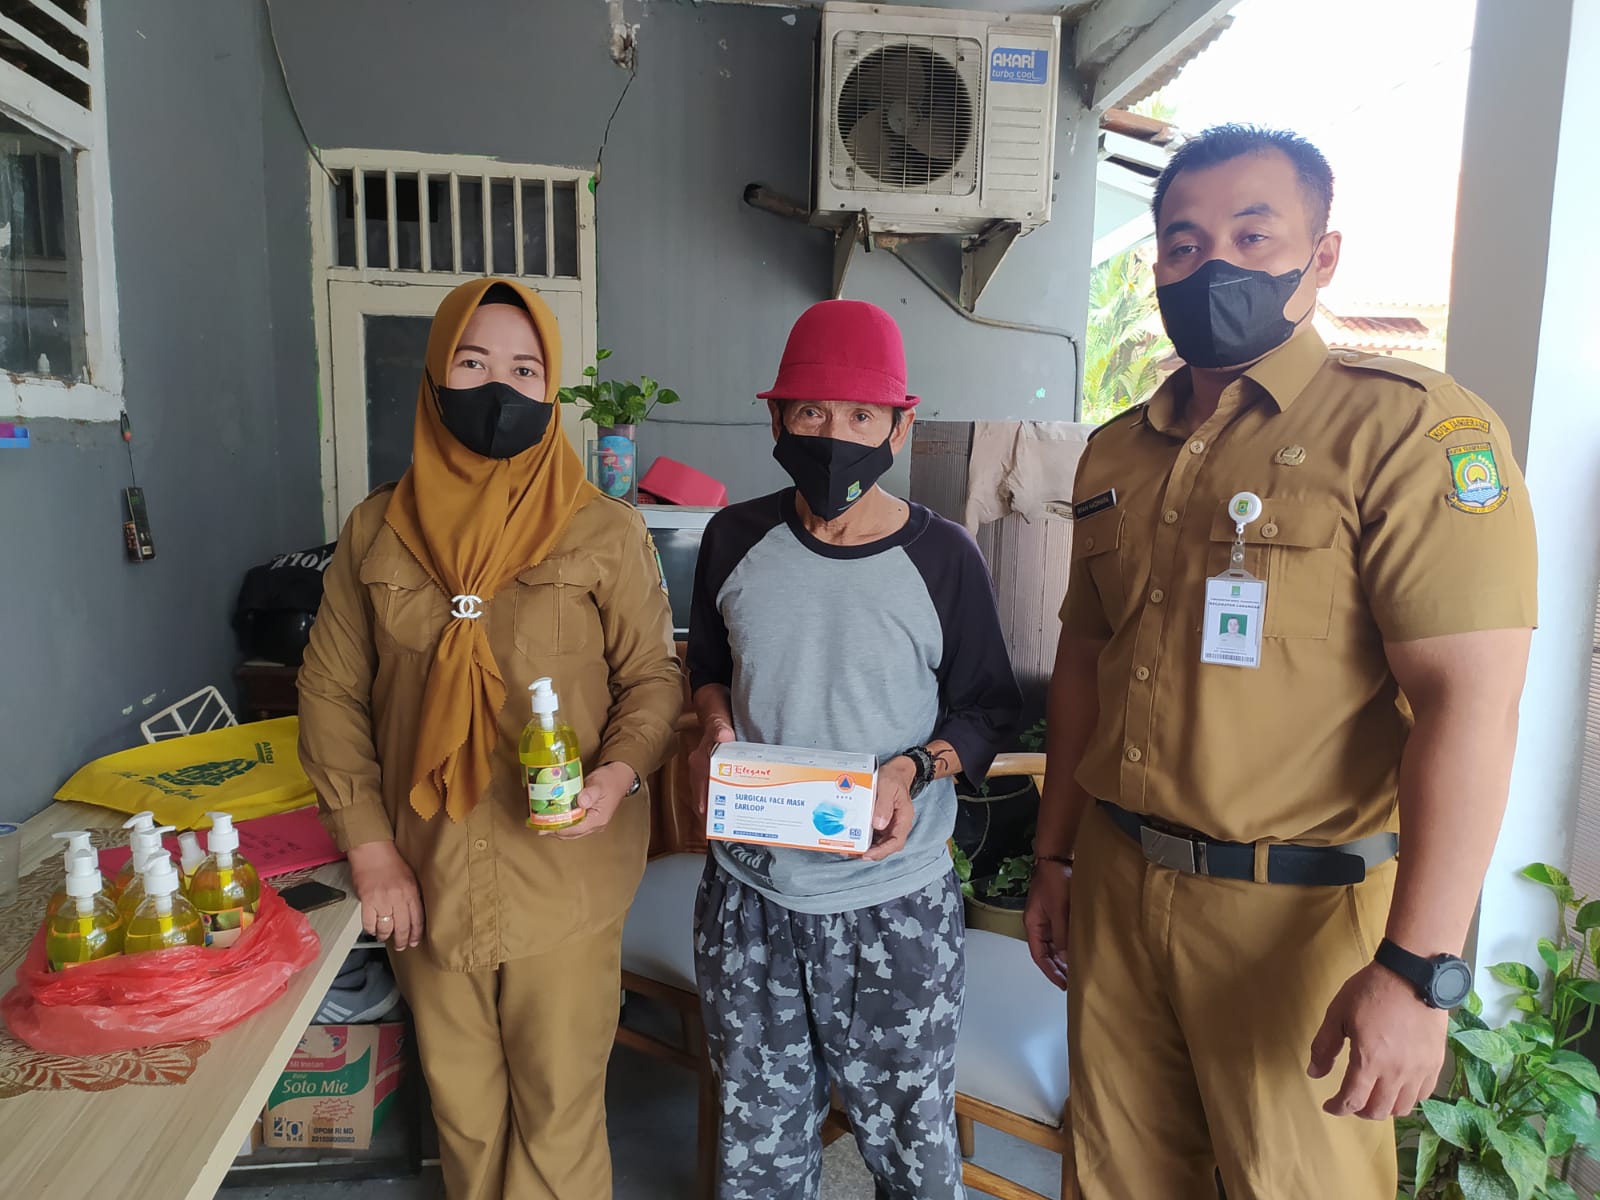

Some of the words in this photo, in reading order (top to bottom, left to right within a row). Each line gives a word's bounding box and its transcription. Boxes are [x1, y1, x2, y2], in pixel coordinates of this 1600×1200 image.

[992, 70, 1014, 78] turbo
[1017, 70, 1036, 79] cool
[735, 765, 771, 776] Elegant
[735, 793, 767, 803] SURGICAL
[786, 798, 805, 807] MASK
[734, 802, 765, 811] EARLOOP
[282, 1080, 316, 1094] Soto
[320, 1080, 349, 1094] Mie
